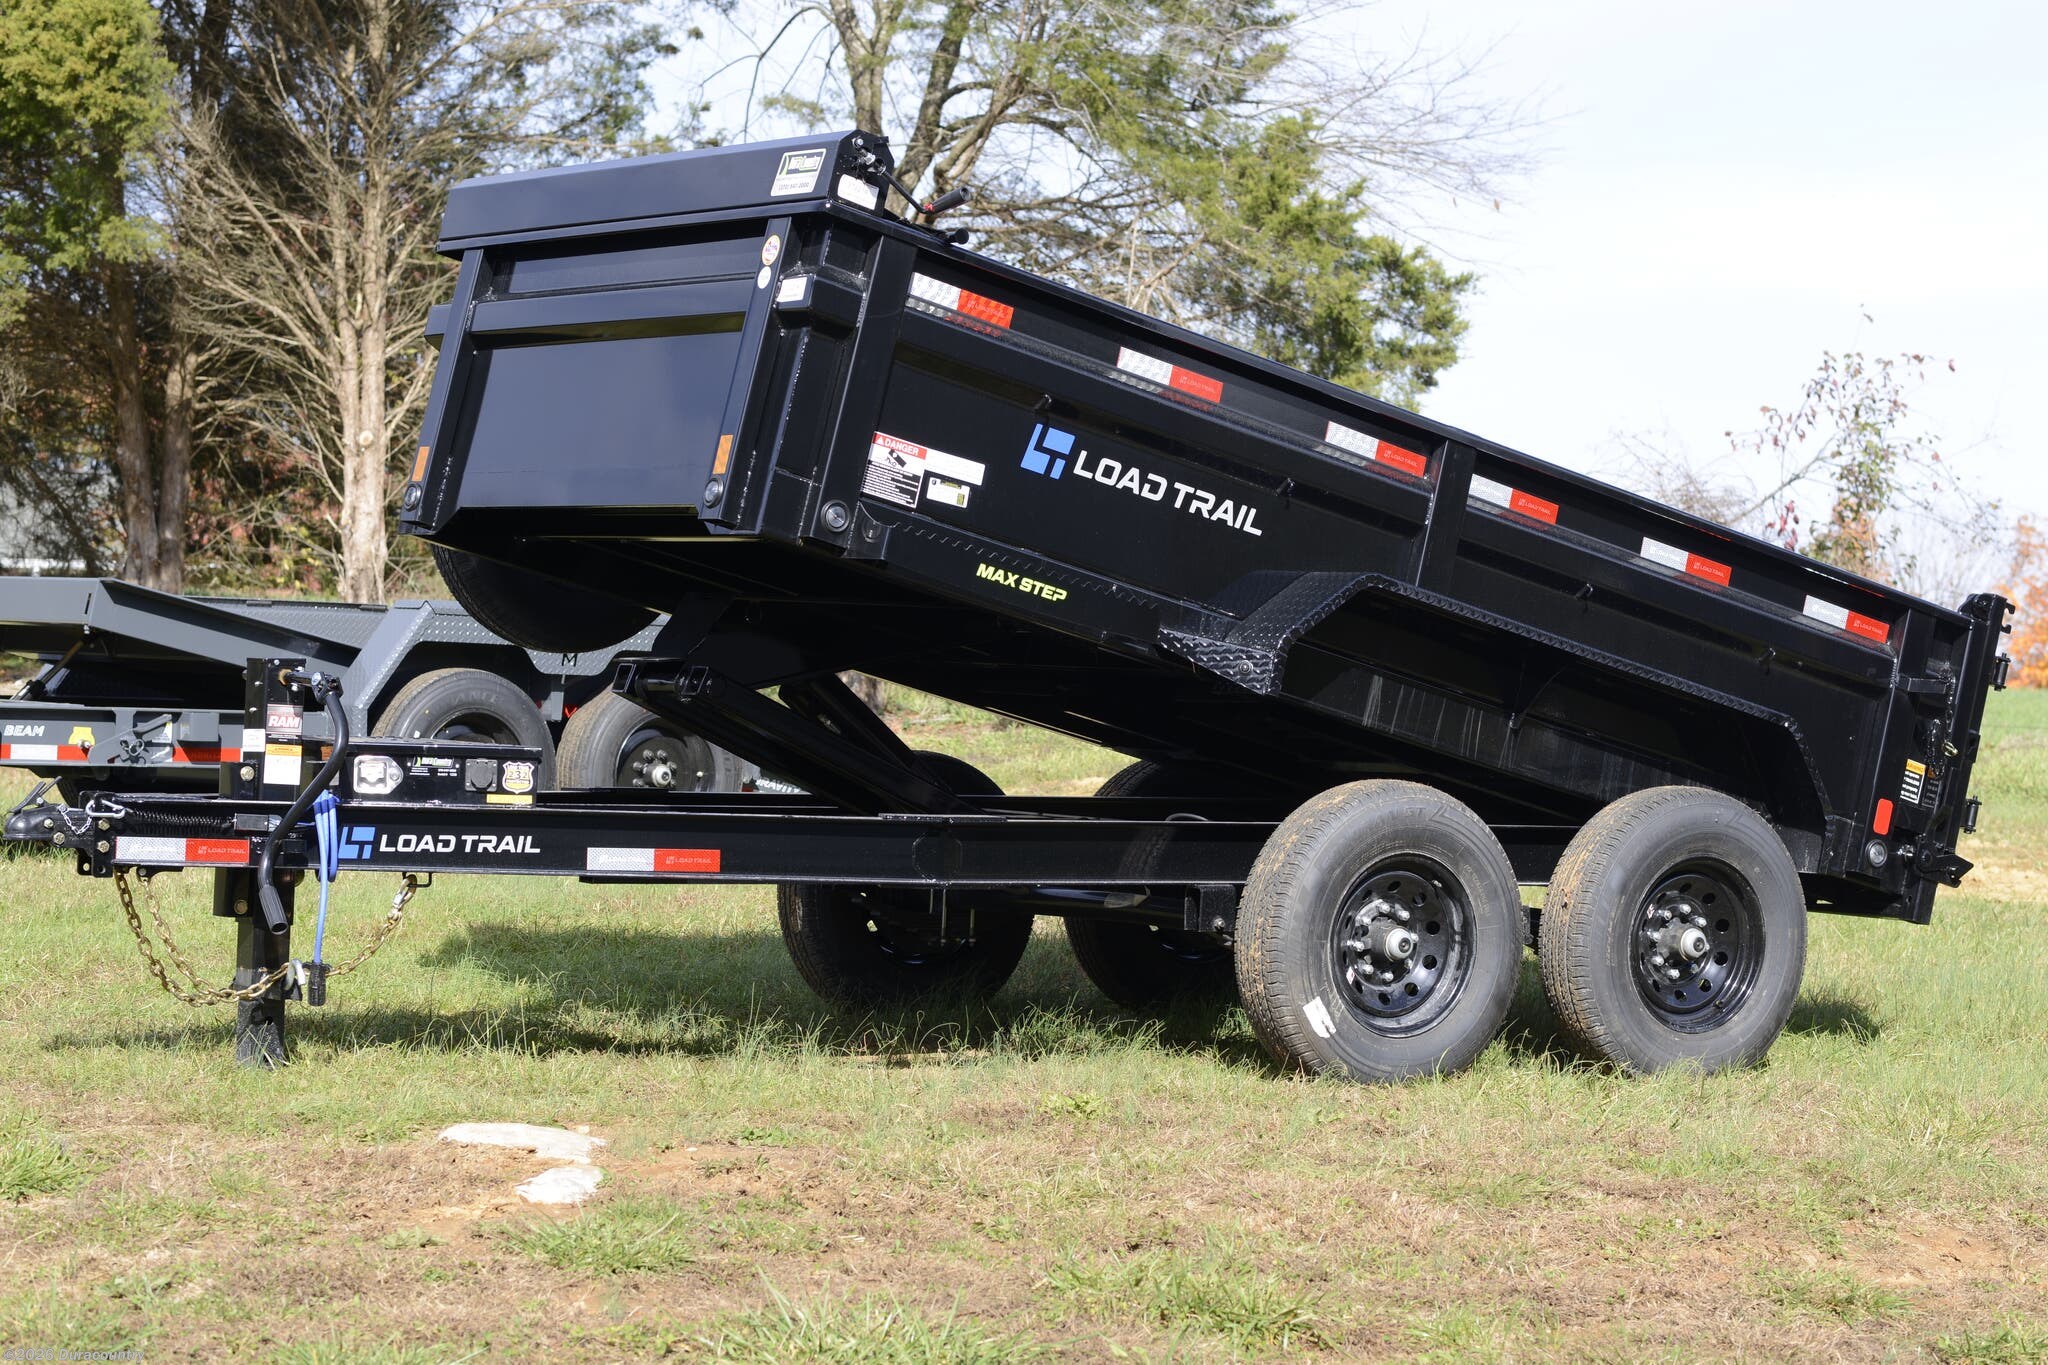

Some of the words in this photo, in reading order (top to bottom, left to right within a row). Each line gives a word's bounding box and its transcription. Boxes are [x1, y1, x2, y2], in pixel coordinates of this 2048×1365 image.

[884, 438, 920, 457] DANGER
[1074, 450, 1168, 502] LOAD
[1173, 481, 1263, 537] TRAIL
[976, 563, 1019, 588] MAX
[1018, 577, 1068, 602] STEP
[4, 725, 45, 737] BEAM
[268, 715, 301, 728] RAM
[508, 770, 528, 780] 232
[379, 834, 457, 853] LOAD
[461, 834, 541, 854] TRAIL
